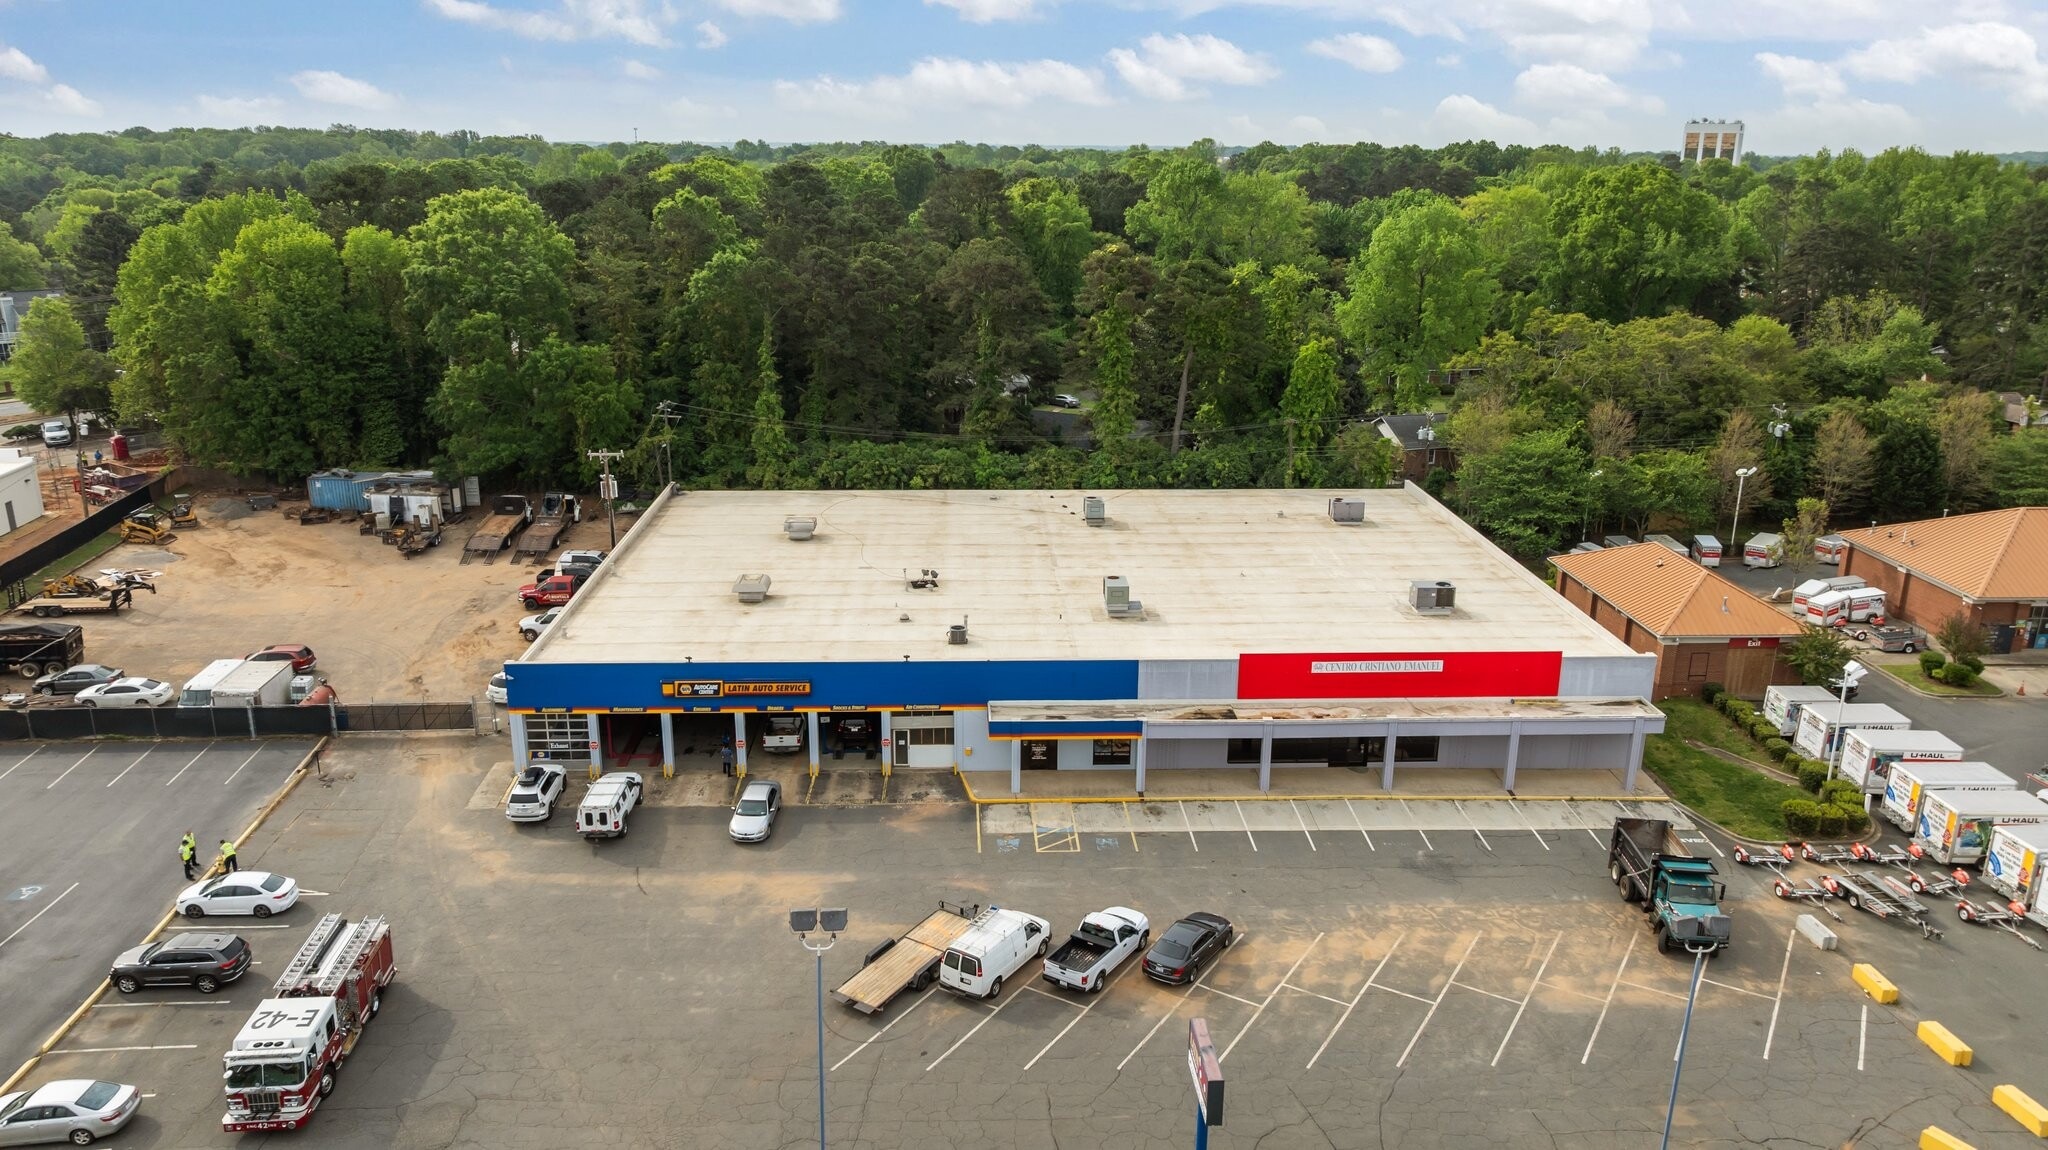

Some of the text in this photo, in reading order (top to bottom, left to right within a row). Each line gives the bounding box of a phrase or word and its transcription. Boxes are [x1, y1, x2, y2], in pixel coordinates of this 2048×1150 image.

[1325, 661, 1442, 671] CENTRO CRISTIANO EMANUEL
[752, 684, 773, 692] AUTO
[775, 684, 806, 692] SERVICE
[251, 1008, 320, 1029] E-42
